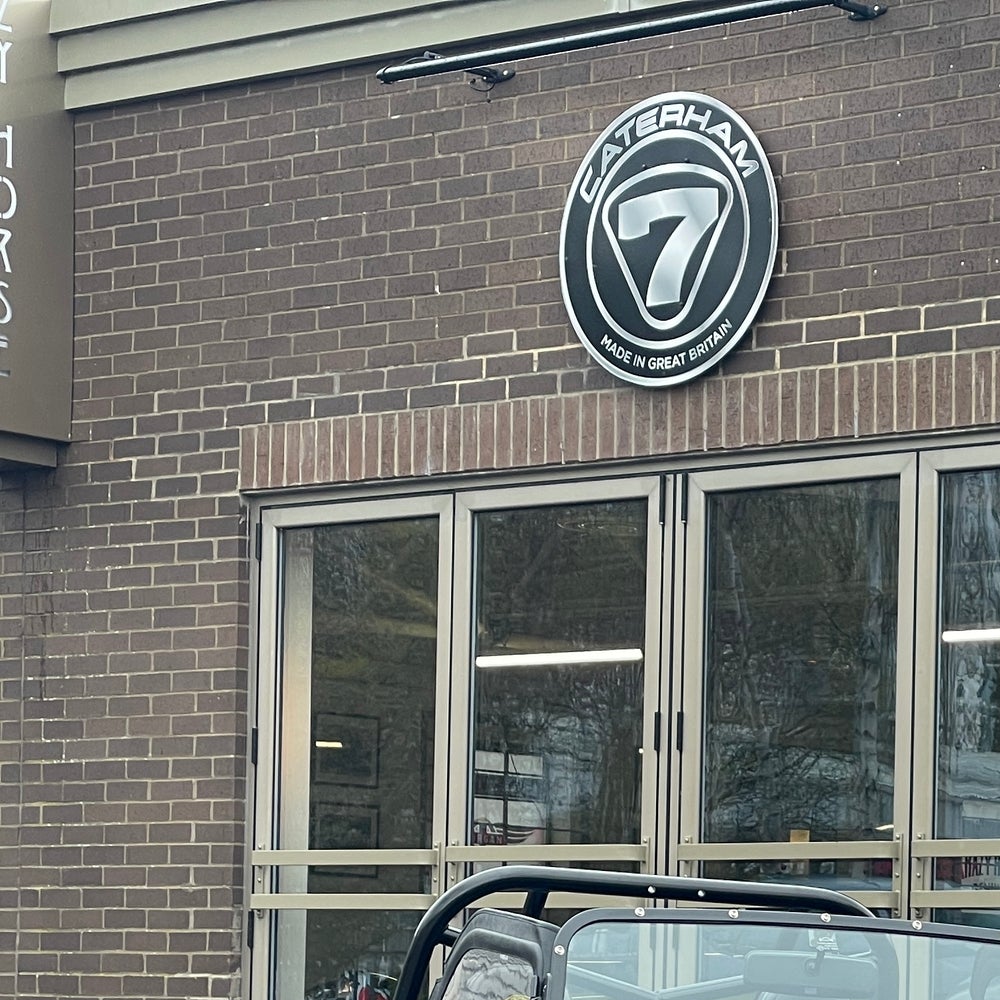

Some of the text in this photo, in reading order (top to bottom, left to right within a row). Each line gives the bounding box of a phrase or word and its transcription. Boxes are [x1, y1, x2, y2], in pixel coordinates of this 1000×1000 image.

[580, 104, 759, 204] CATERHAM
[618, 187, 719, 307] 7
[600, 318, 733, 370] MADE IN GREAT BRITAIN
